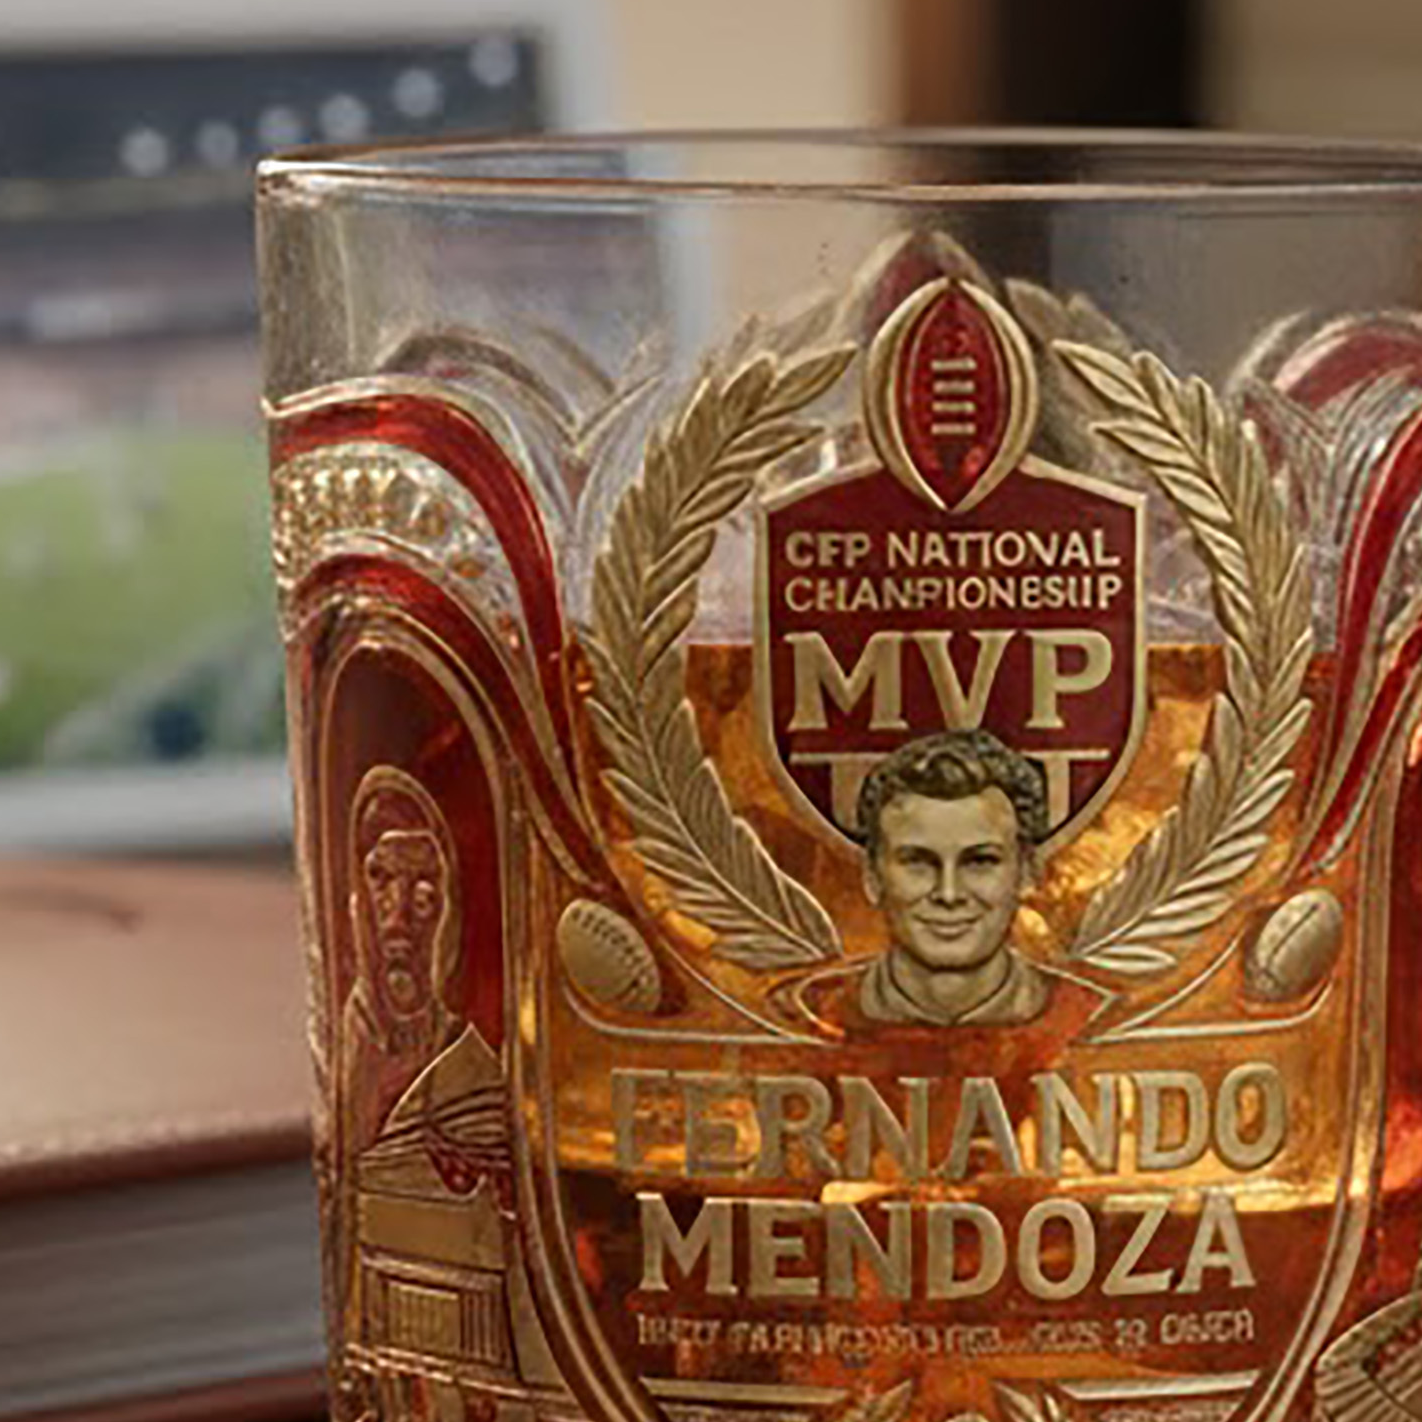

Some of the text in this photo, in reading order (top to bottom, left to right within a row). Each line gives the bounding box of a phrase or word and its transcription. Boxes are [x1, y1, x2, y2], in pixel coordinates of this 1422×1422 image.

[887, 528, 1121, 569] NATIONAL
[784, 628, 1113, 731] MVP
[611, 1062, 1287, 1180] FERNANDO
[635, 1188, 1257, 1301] MENDOZA
